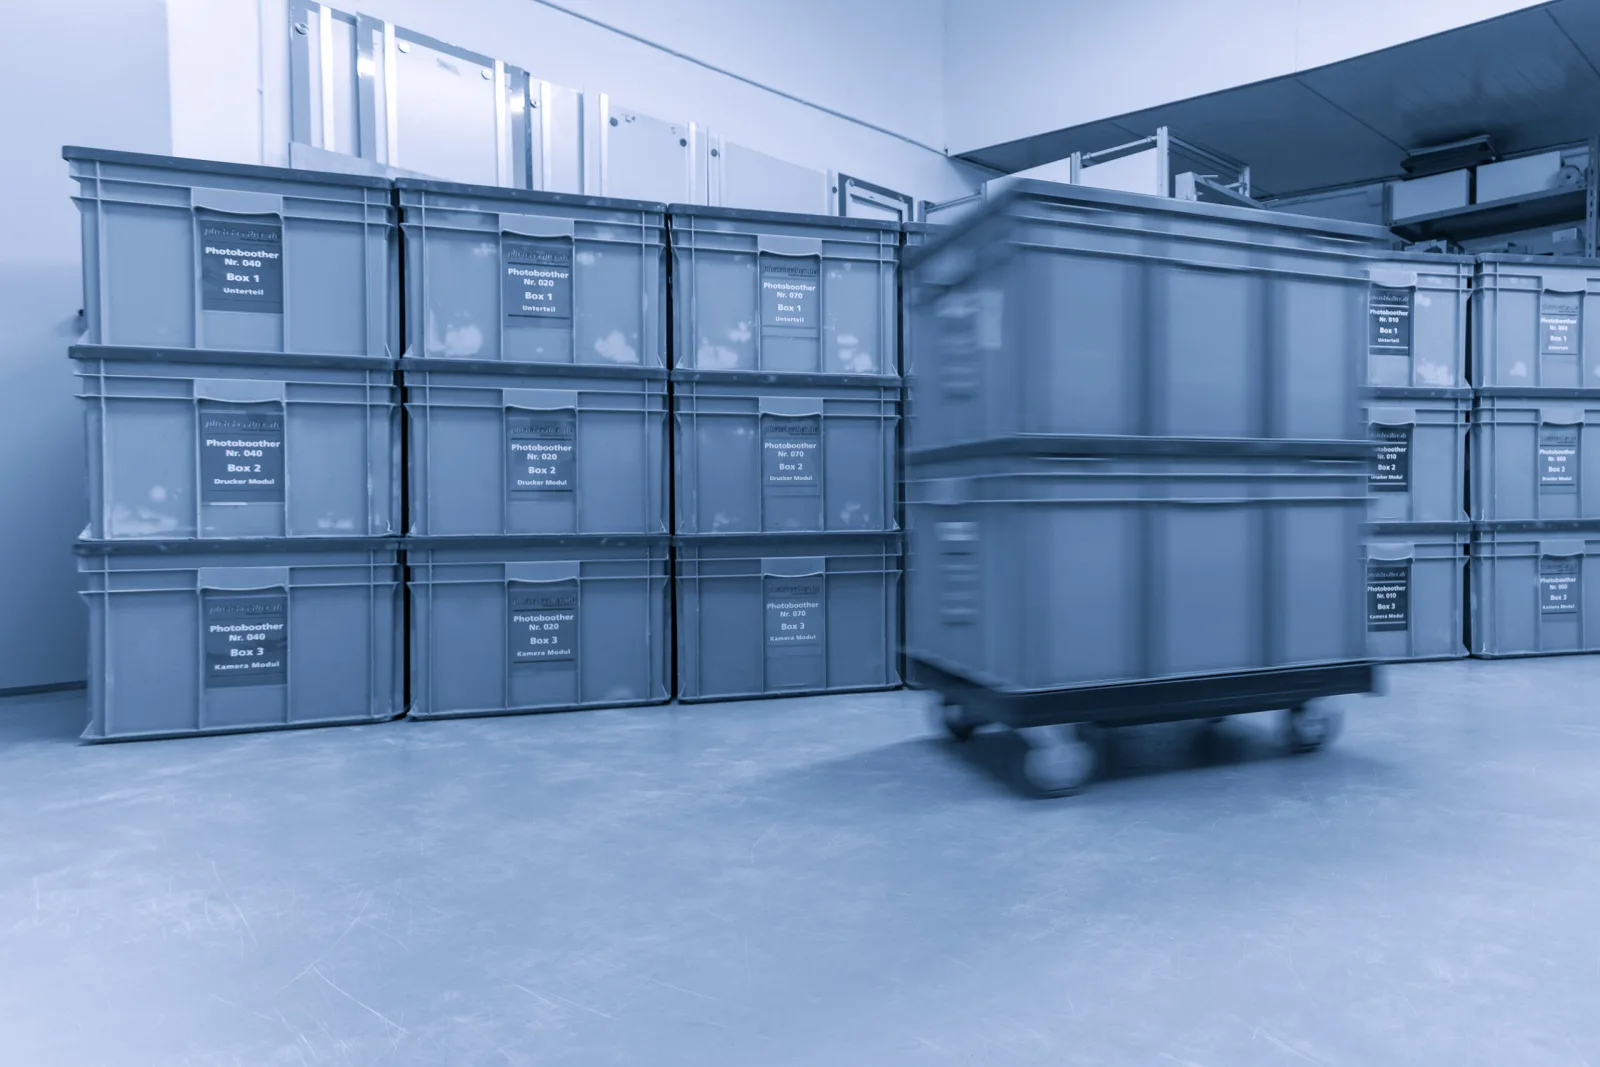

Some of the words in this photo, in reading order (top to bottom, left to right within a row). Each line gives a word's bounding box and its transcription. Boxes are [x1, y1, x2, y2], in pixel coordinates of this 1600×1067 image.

[205, 247, 279, 260] Photoboother
[225, 259, 239, 267] Nr.
[243, 260, 262, 268] 040
[227, 273, 250, 283] Box
[254, 274, 260, 283] 1
[508, 268, 569, 279] Photoboother
[539, 279, 554, 287] 020
[764, 282, 816, 293] Photoboother
[223, 288, 264, 296] Unterteil
[525, 292, 545, 300] Box
[547, 293, 552, 301] 1
[522, 305, 556, 313] Unterteil
[778, 304, 794, 312] Box
[797, 304, 801, 312] 1
[206, 439, 281, 449] Photoboother
[511, 444, 572, 452] Photoboother
[765, 442, 816, 450] Photoboother
[226, 450, 240, 458] Nr.
[243, 449, 263, 458] 040
[227, 464, 250, 473] Box
[254, 464, 262, 472] 2
[528, 466, 547, 475] Box
[767, 601, 819, 610] Photoboother
[513, 614, 574, 623] Photoboother
[210, 622, 284, 633] Photoboother
[529, 623, 541, 631] Nr.
[781, 623, 797, 631] Box
[799, 622, 805, 630] 3
[230, 634, 244, 642] Nr.
[246, 633, 266, 642] 040
[530, 637, 549, 645] Box
[551, 636, 558, 644] 3
[230, 648, 253, 658] Box
[257, 647, 264, 656] 3
